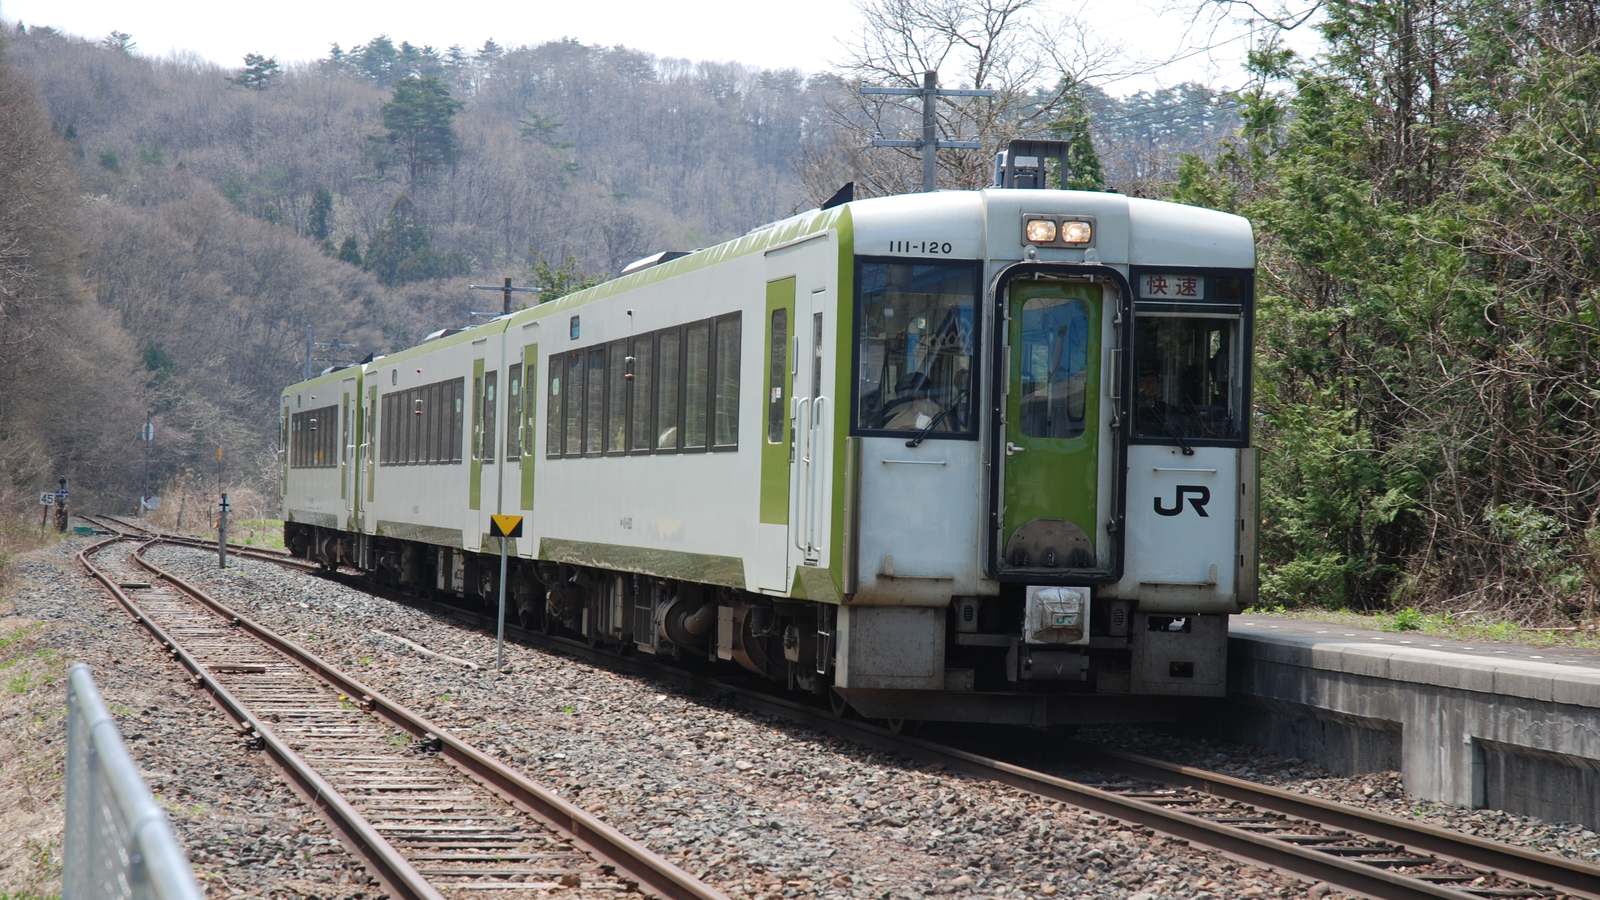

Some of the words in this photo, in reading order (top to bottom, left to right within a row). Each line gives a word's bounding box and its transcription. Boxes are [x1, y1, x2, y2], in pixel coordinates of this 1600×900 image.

[889, 240, 952, 254] 111-120
[1146, 275, 1198, 297] 快速
[41, 494, 54, 504] 45
[1154, 485, 1210, 517] JR
